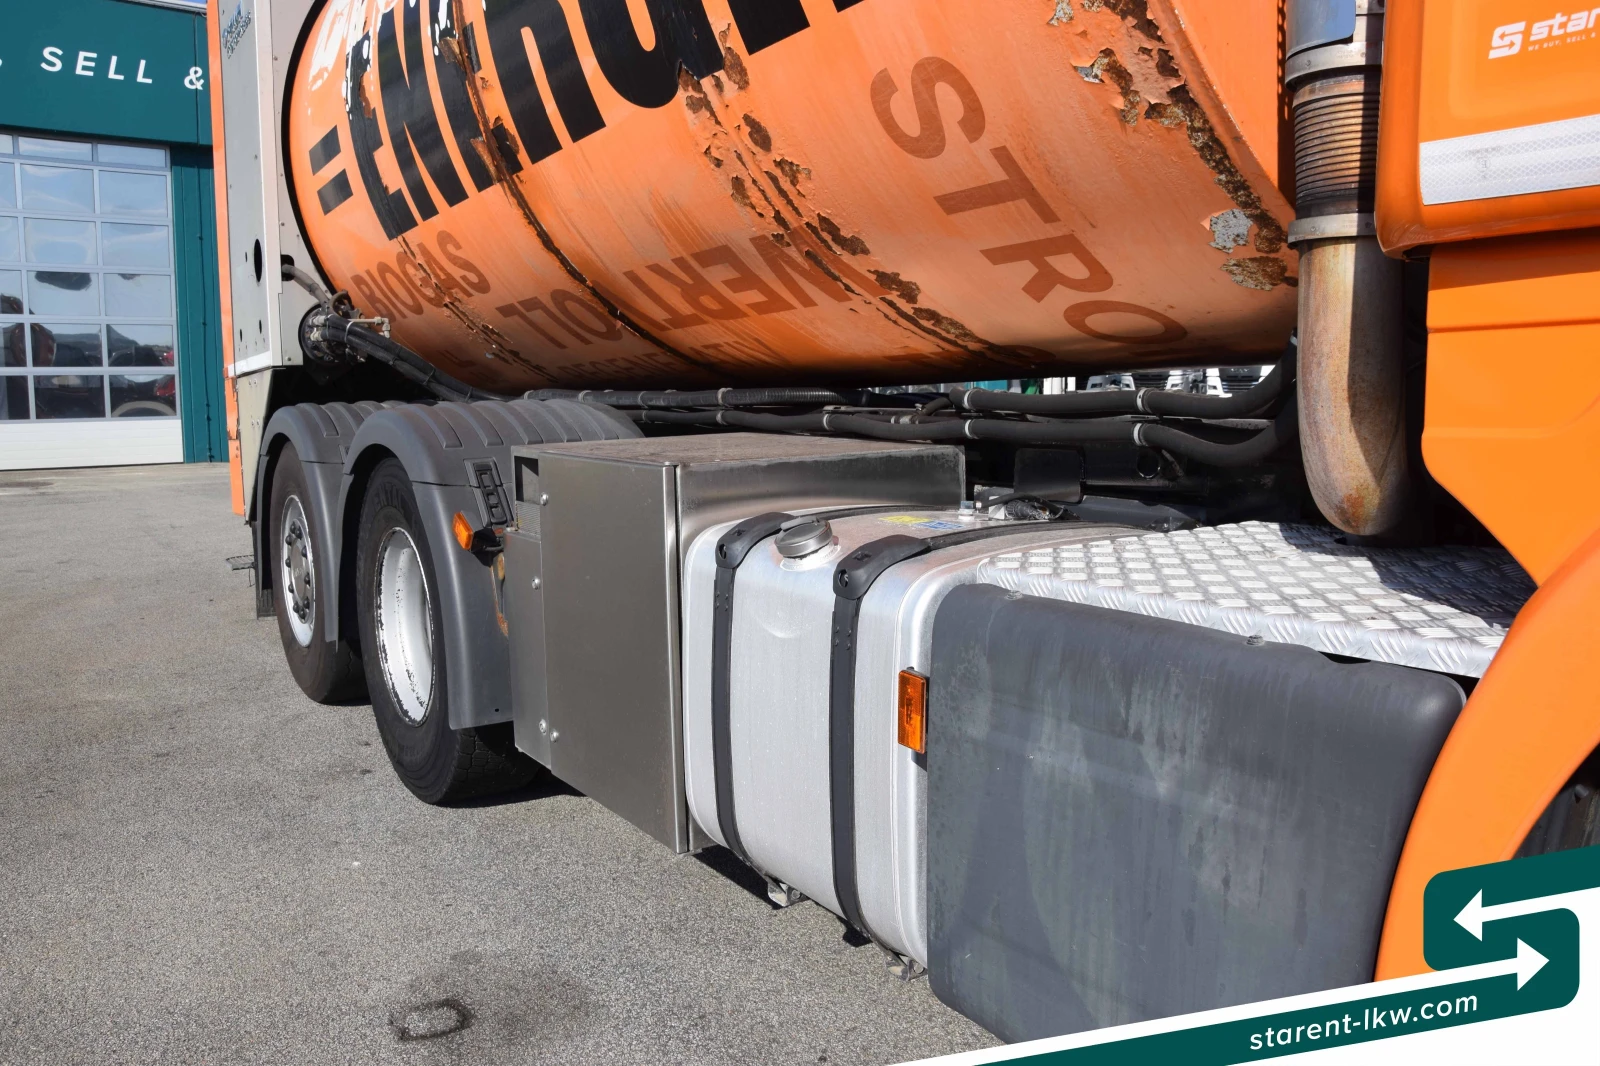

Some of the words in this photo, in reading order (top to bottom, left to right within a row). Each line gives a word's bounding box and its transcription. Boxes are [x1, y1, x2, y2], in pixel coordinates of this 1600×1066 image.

[40, 46, 153, 84] SELL
[183, 66, 205, 90] &
[1566, 34, 1587, 43] SELL
[870, 56, 1189, 350] STRO
[350, 229, 491, 325] BIOGAS
[495, 225, 893, 350] WERTVOLL
